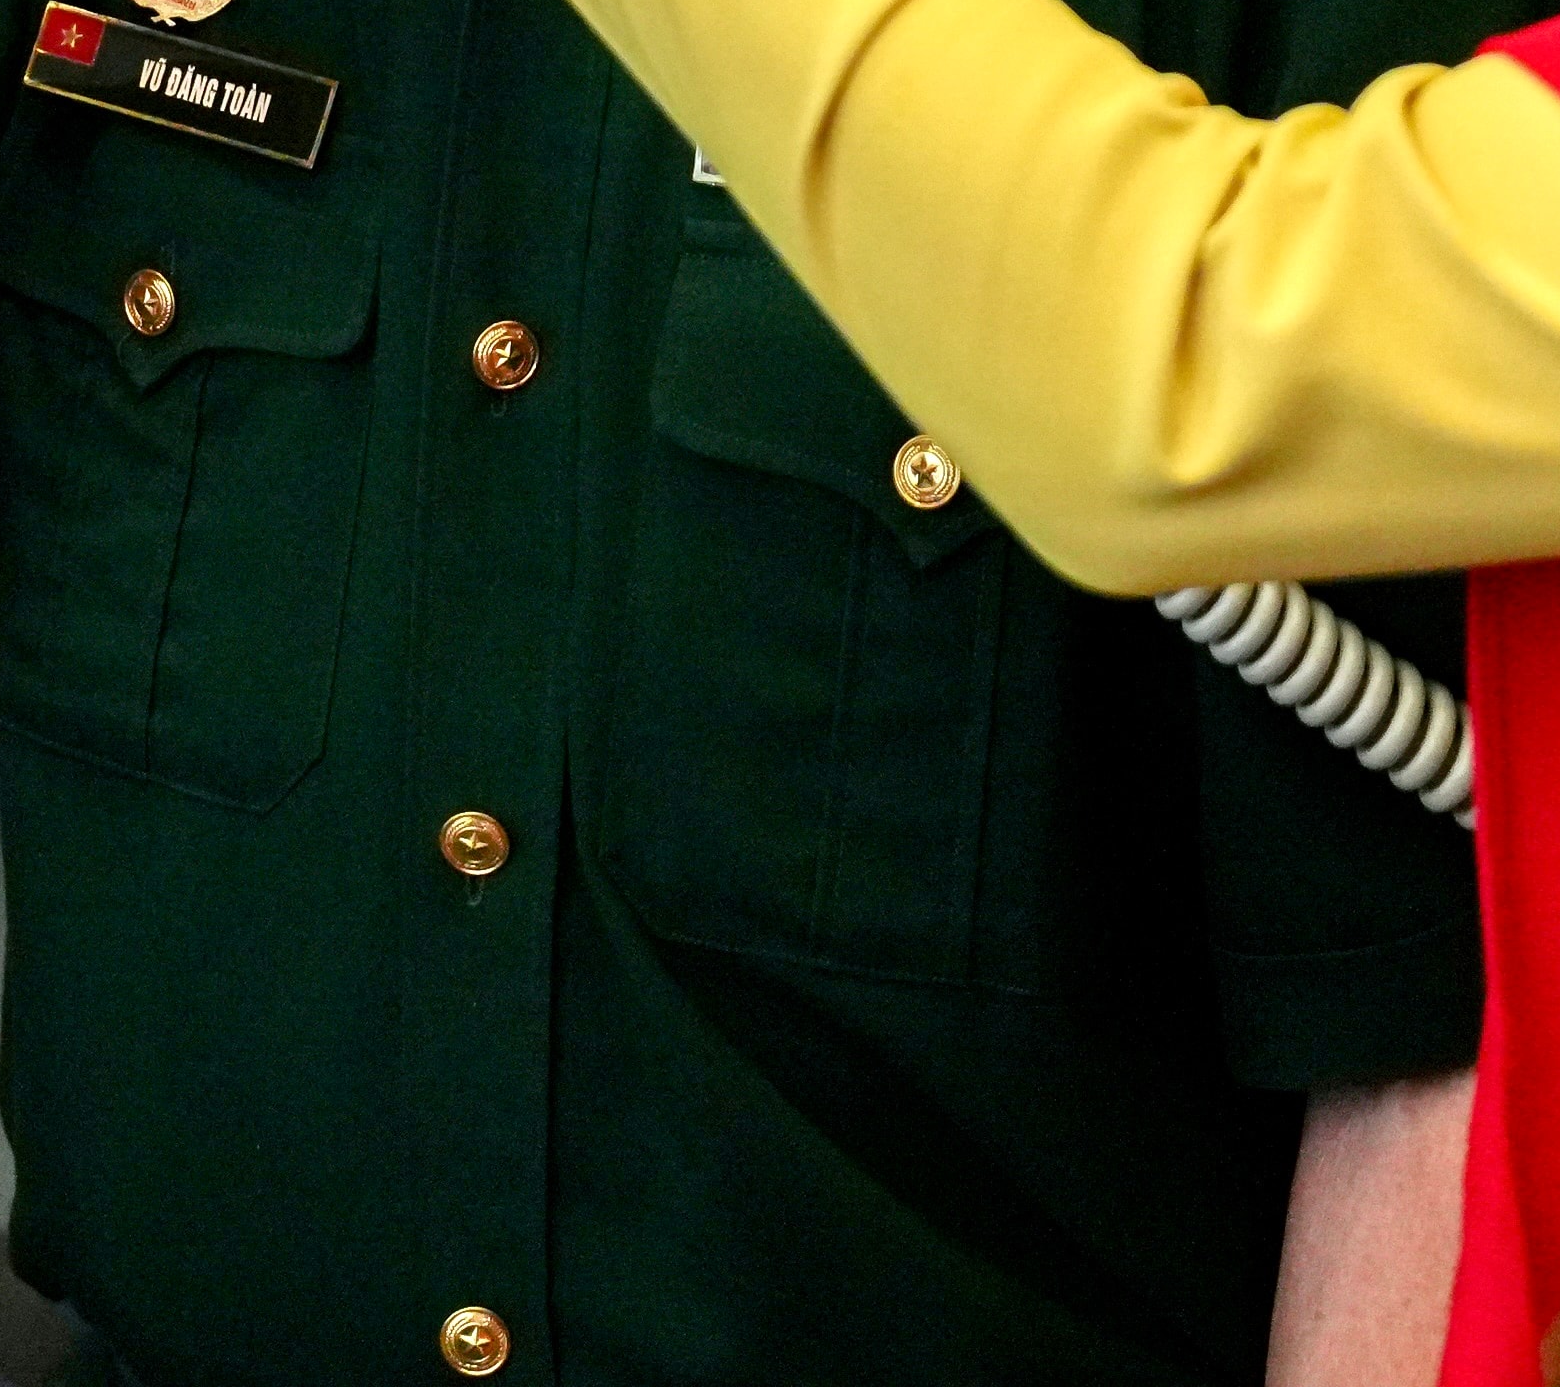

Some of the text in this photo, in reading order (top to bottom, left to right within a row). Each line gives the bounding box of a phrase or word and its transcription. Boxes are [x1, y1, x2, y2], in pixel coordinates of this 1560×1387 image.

[139, 57, 273, 124] VŨ ĐĂNG TOÀN
